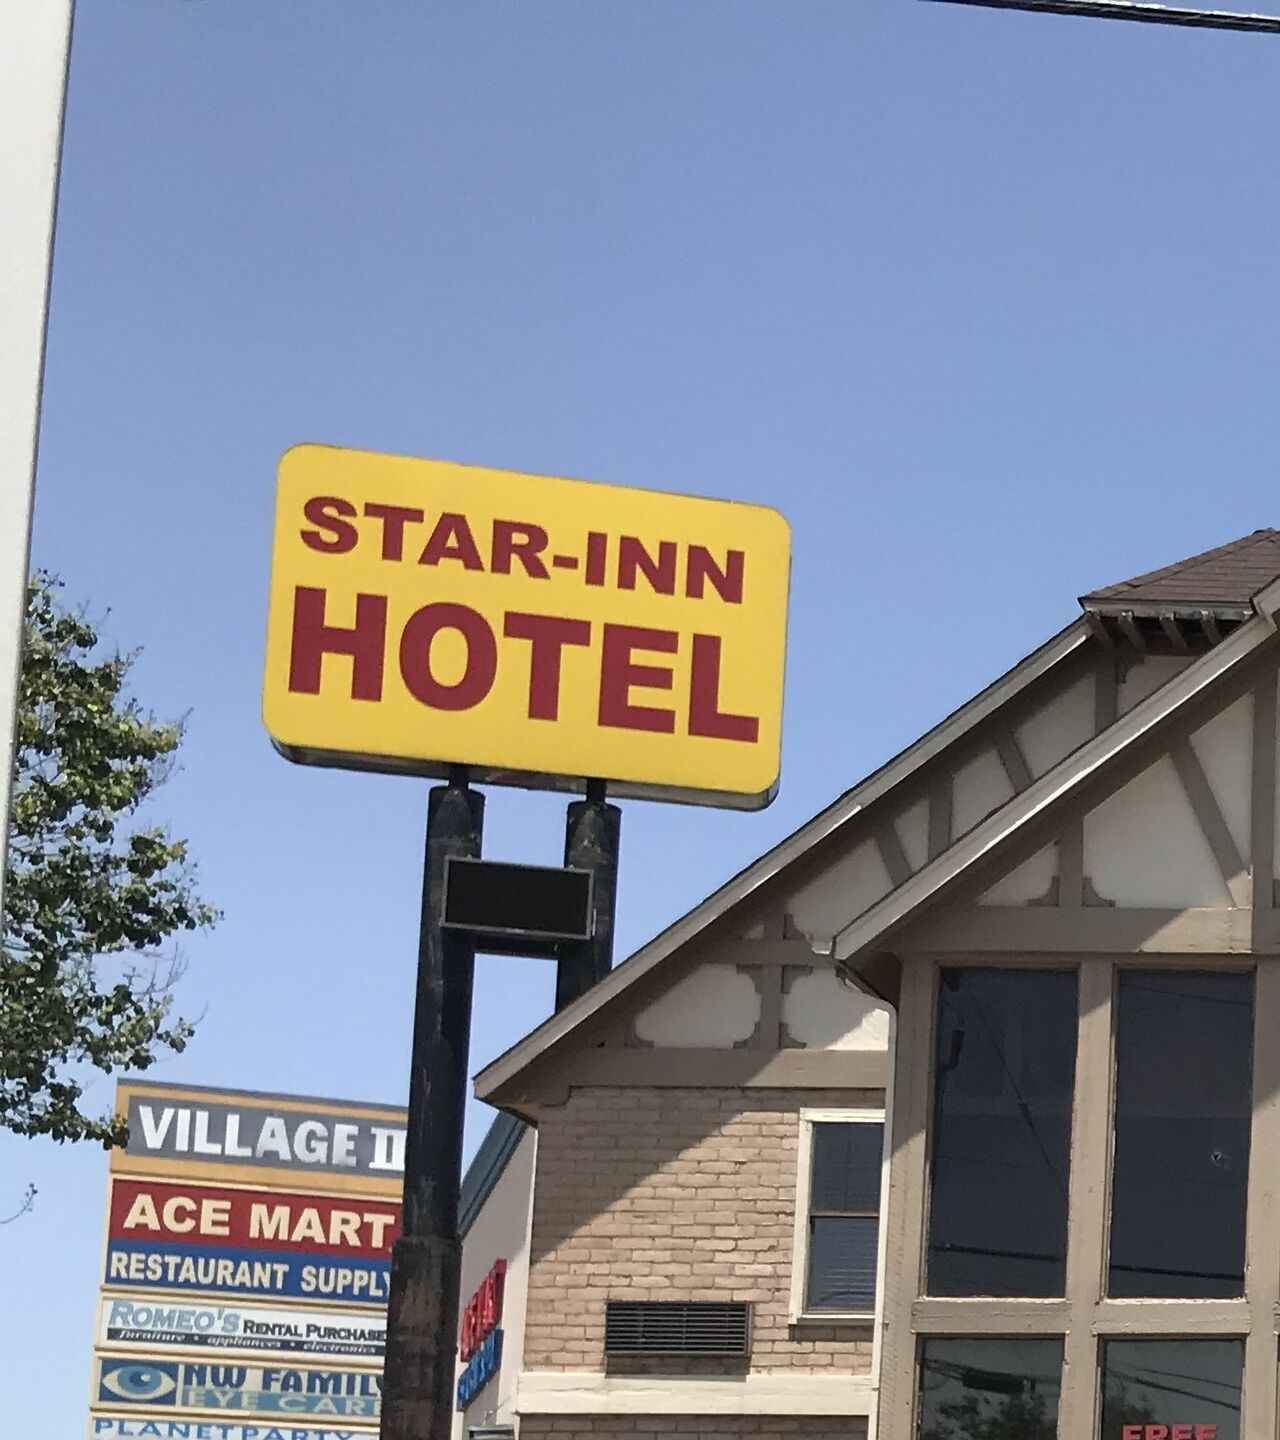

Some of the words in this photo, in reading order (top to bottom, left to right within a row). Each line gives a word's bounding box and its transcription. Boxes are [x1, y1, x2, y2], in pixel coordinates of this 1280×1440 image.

[300, 496, 745, 604] STAR-INN
[288, 585, 759, 744] HOTEL
[138, 1105, 359, 1167] VILLAGE
[123, 1193, 232, 1236] ACE
[249, 1203, 396, 1248] MART
[110, 1251, 290, 1290] RESTAURANT
[108, 1301, 241, 1333] ROMEO'S
[243, 1319, 303, 1338] RENTAL
[183, 1364, 246, 1387] NW
[188, 1387, 259, 1409] EYE
